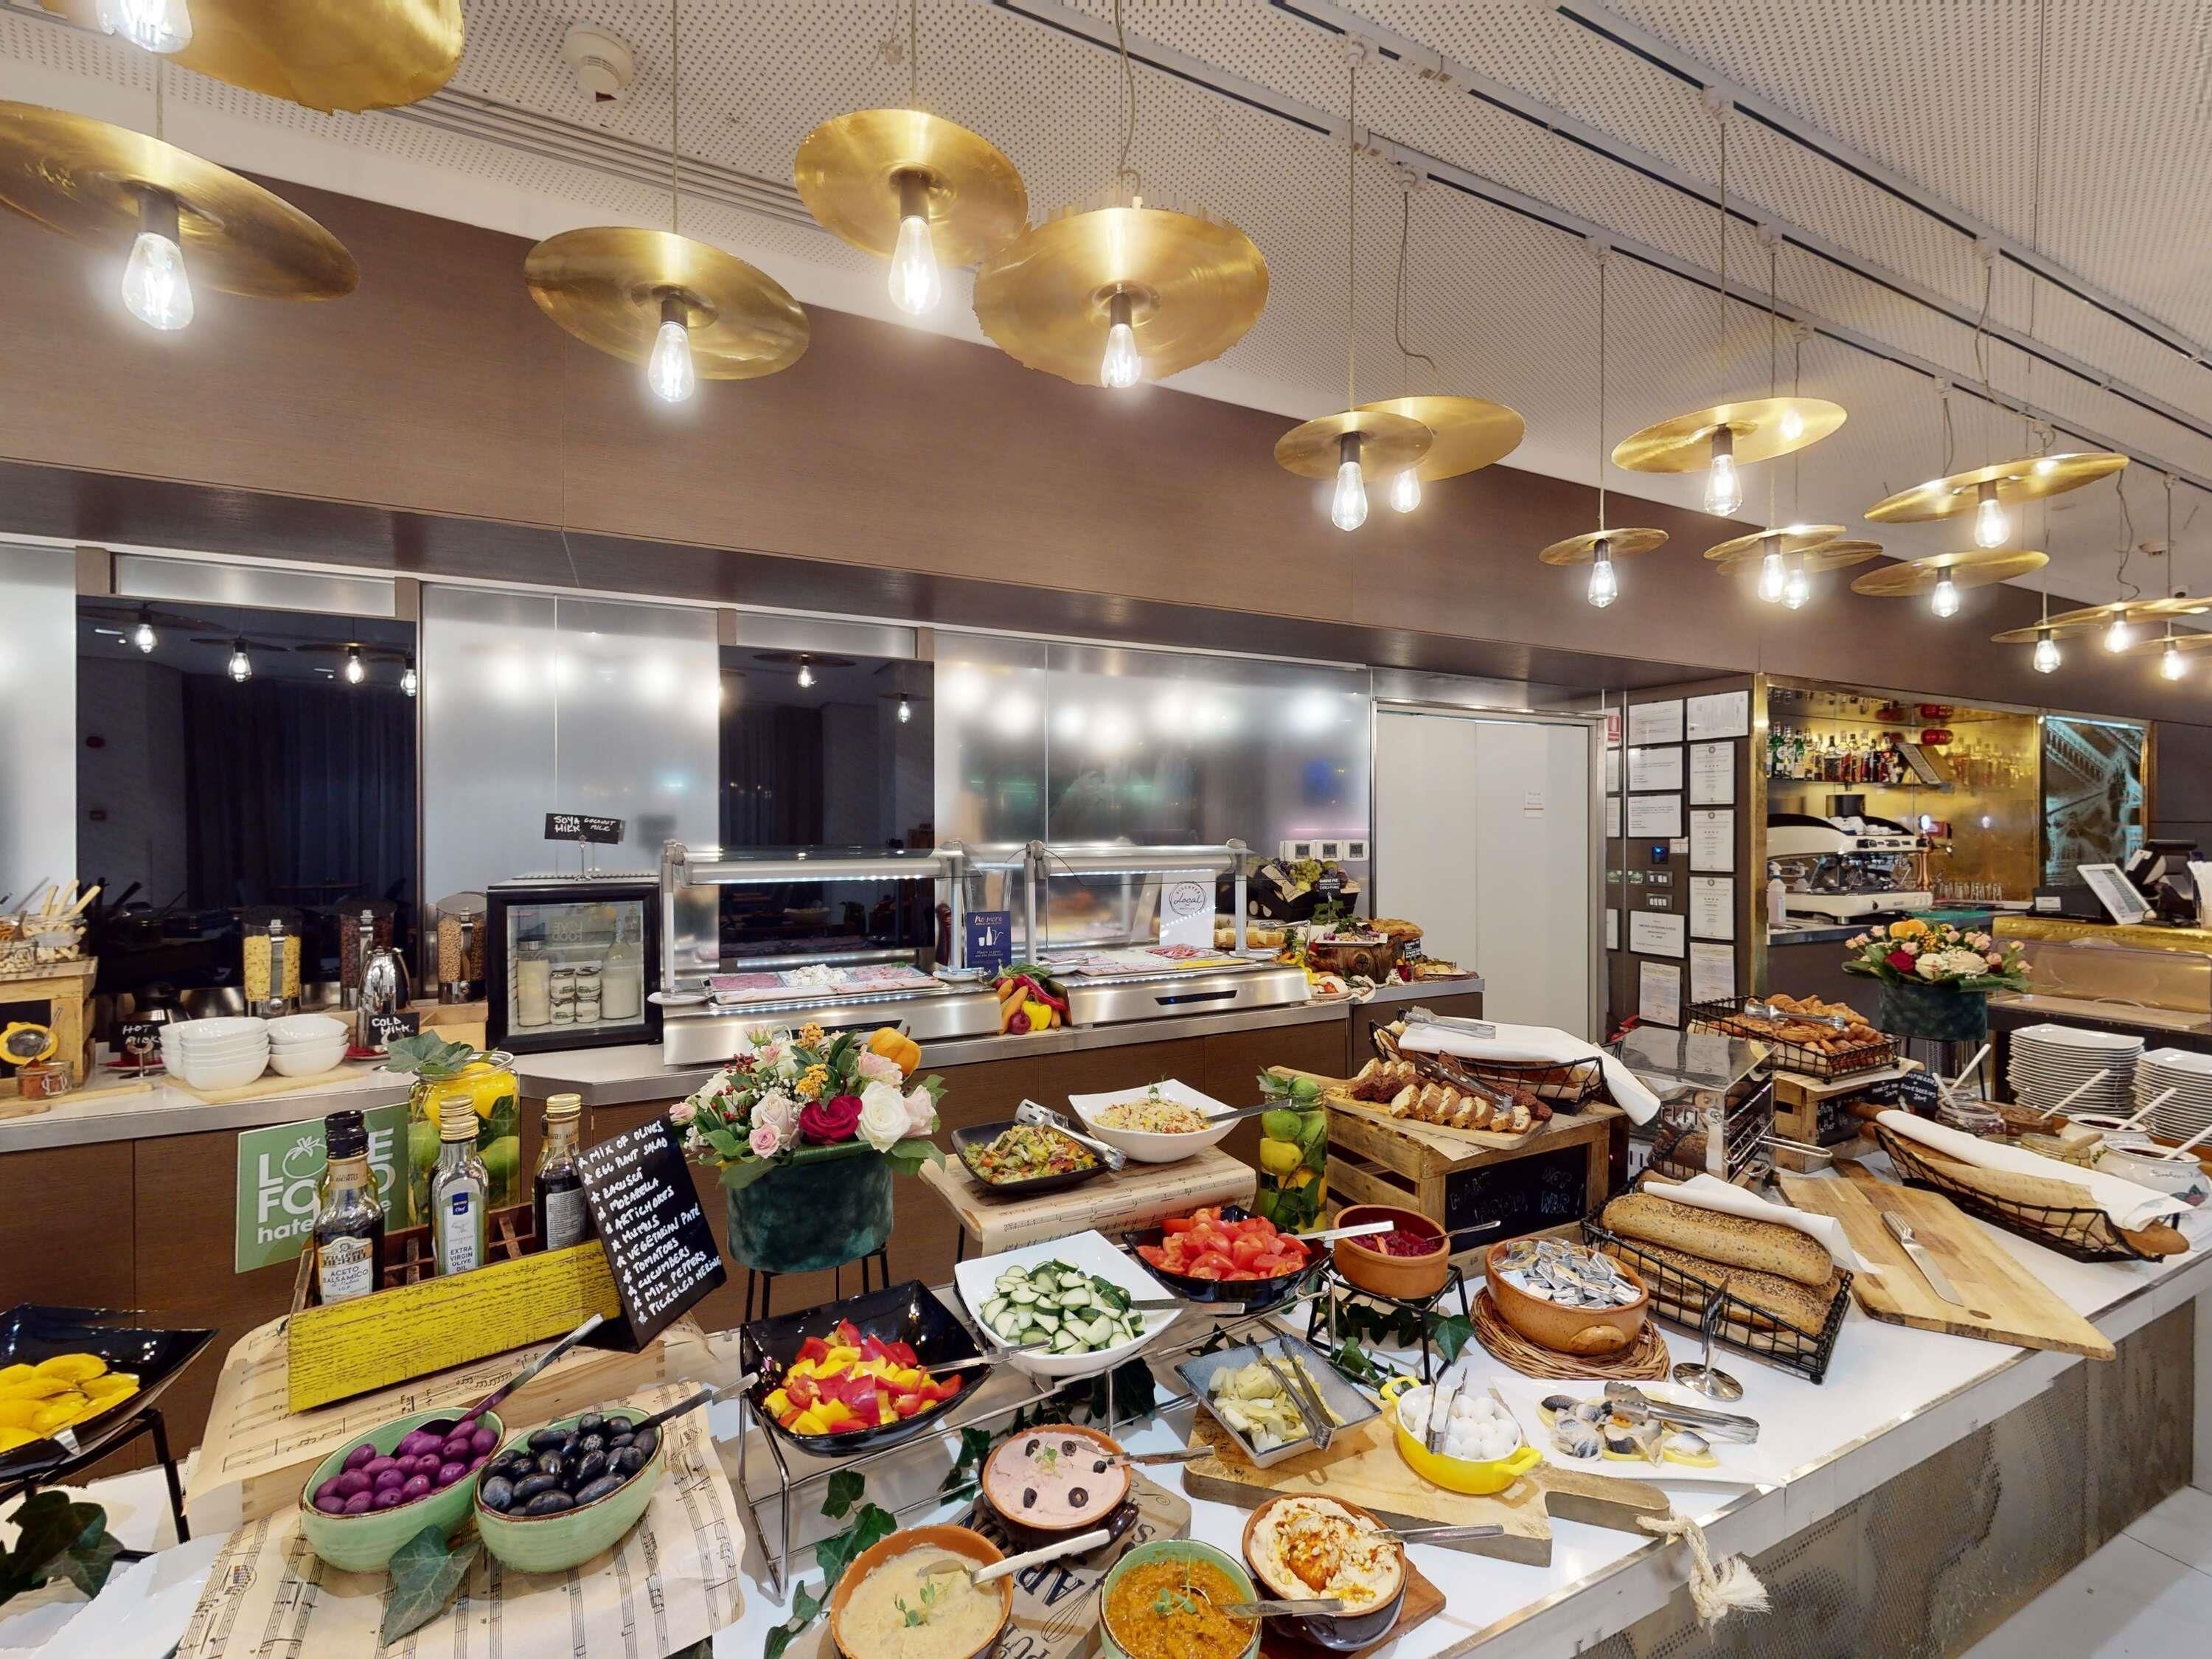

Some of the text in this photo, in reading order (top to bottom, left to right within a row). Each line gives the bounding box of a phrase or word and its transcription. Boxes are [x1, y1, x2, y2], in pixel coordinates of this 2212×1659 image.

[554, 815, 580, 826] SOYA
[554, 824, 580, 833] MILK
[372, 1017, 401, 1026] COLD
[122, 1025, 152, 1034] HOT
[380, 1025, 409, 1035] MILK
[590, 1120, 664, 1164] MIX OF OLIVES
[595, 1137, 668, 1178] EGG PLANT SALAD
[609, 1178, 659, 1211] MOZARELLA
[258, 1218, 315, 1245] hate
[622, 1214, 660, 1244] HUMUS
[451, 1245, 473, 1255] EXTRA
[633, 1237, 679, 1274] TOMATOES
[450, 1253, 473, 1262] VIRGIN
[451, 1258, 472, 1266] OLIVE
[330, 1266, 359, 1277] ACETO
[638, 1245, 690, 1289] CUCUMBERS
[323, 1269, 369, 1283] BALSAMICO
[644, 1251, 706, 1301] MIX PEPPERS
